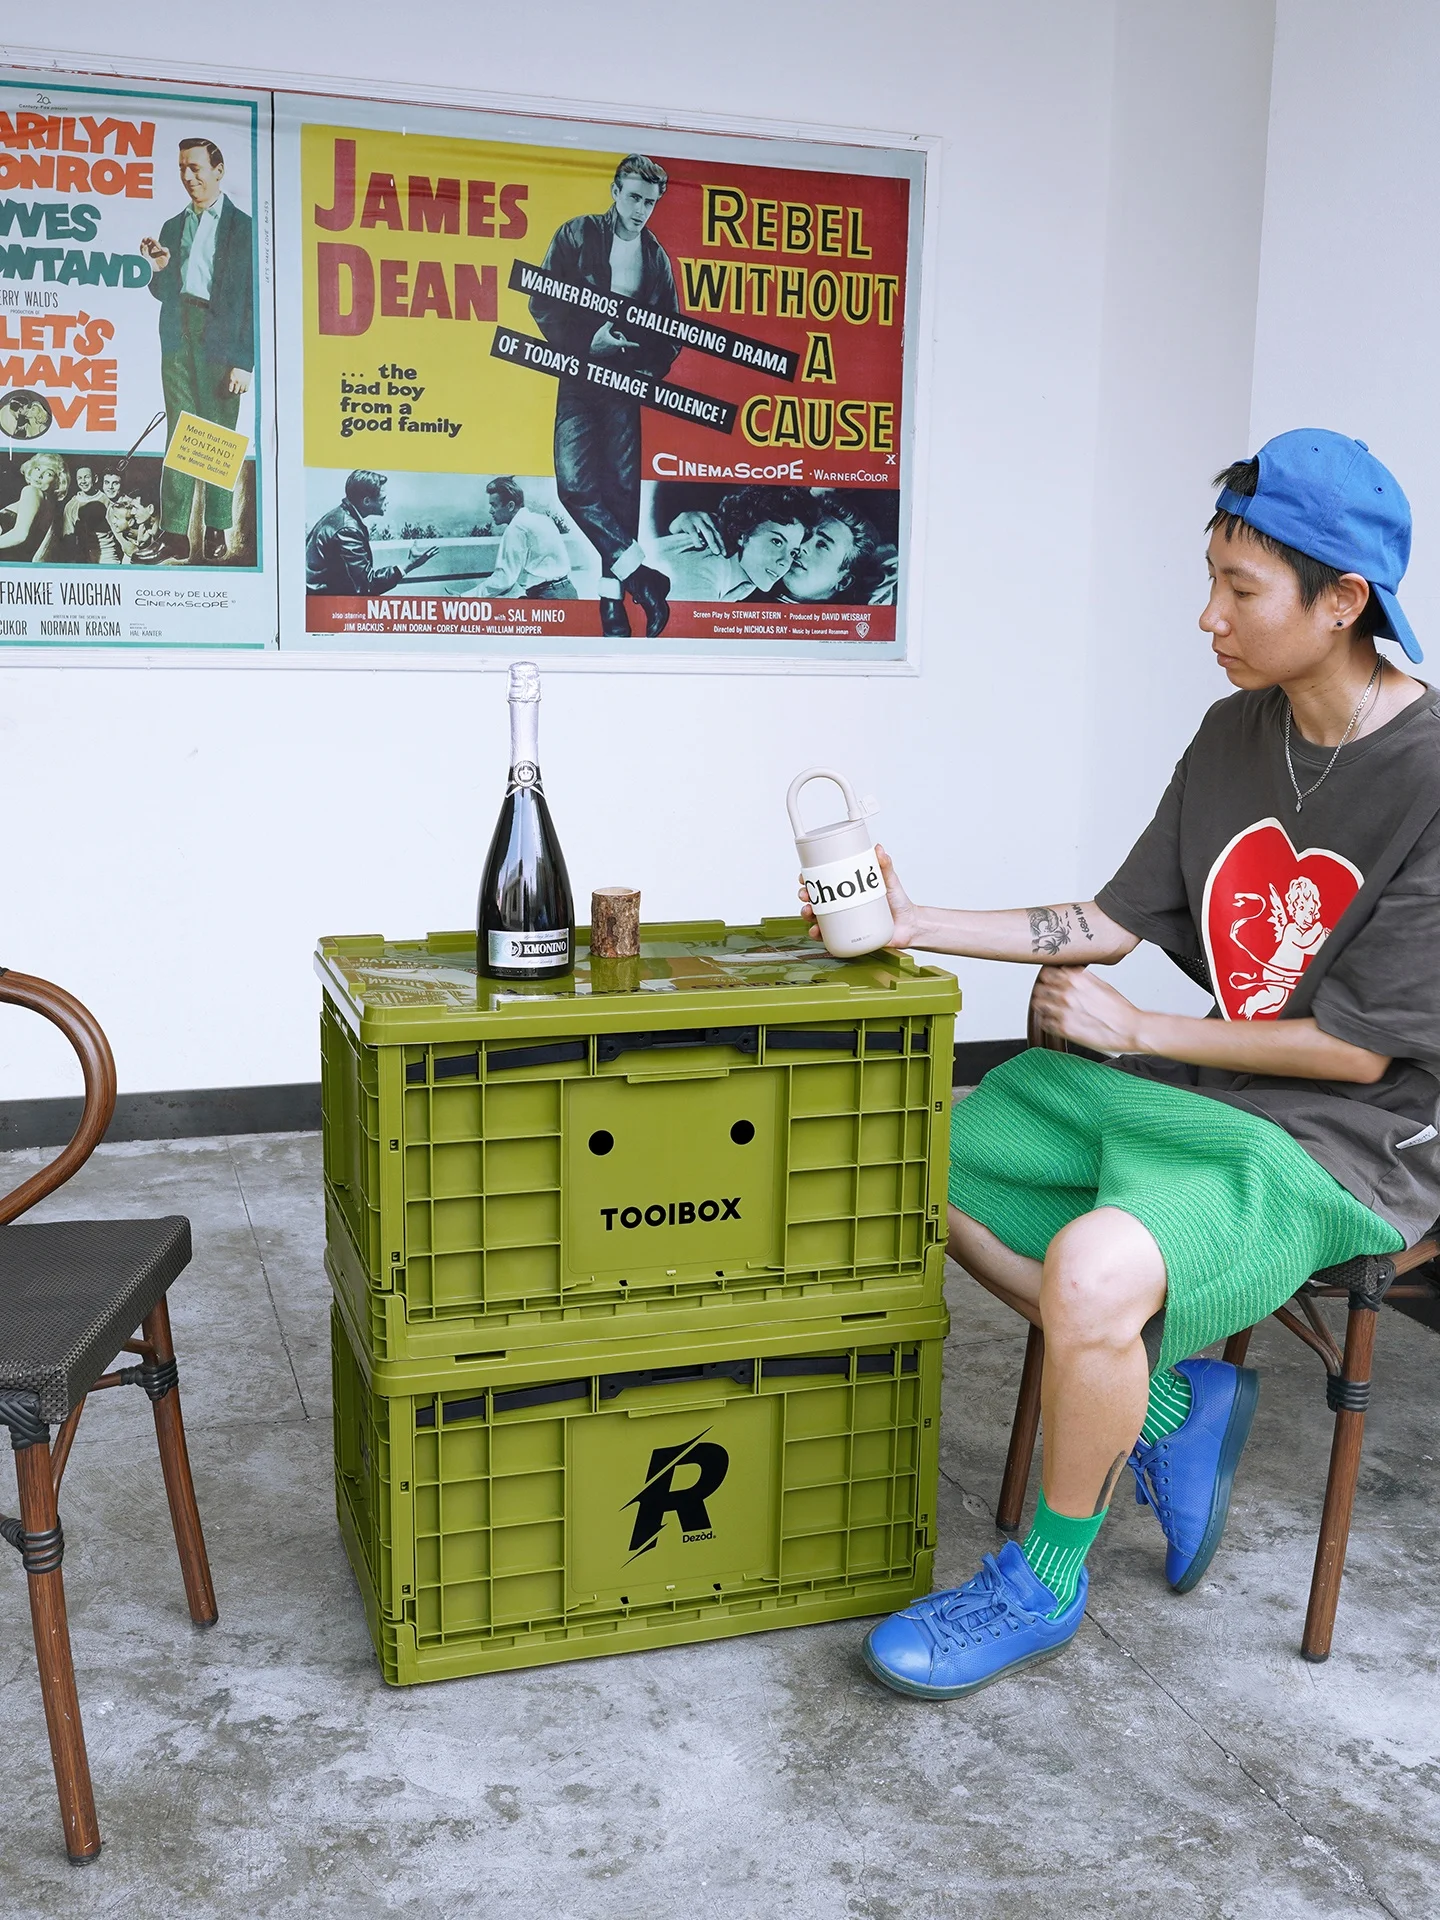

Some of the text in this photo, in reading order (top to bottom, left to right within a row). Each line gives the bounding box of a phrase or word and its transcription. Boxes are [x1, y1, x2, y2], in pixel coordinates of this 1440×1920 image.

[314, 137, 529, 240] JAMES
[701, 184, 872, 260] REBEL
[24, 291, 59, 309] WALD'S
[317, 241, 498, 337] DEAN
[677, 257, 899, 326] WITHOUT
[520, 267, 580, 305] WARNER
[626, 305, 727, 353] CHALLENGING
[731, 340, 789, 375] DRAMA
[801, 331, 837, 384] A
[378, 363, 417, 380] the
[498, 334, 727, 425] OF TODAY'S TEENAGE VIOLENCE!
[341, 379, 425, 402] bad boy
[340, 396, 412, 415] from a
[340, 416, 462, 438] good family
[741, 394, 894, 452] CAUSE
[182, 435, 235, 461] MONTAND!
[186, 424, 238, 450] Meet that man
[176, 453, 186, 461] new
[188, 457, 206, 468] Monroe
[180, 445, 190, 453] He's
[191, 449, 214, 462] dedicated
[222, 461, 231, 469] the
[0, 581, 121, 606] FRANKIE VAUGHAN
[135, 589, 171, 597] COLOR
[174, 591, 185, 599] by
[344, 612, 366, 620] starring
[367, 600, 437, 620] NATALIE
[442, 601, 492, 621] WOOD
[507, 608, 527, 622] SAL
[531, 609, 565, 623] MINEO
[693, 610, 711, 618] Screen
[711, 611, 723, 619] Play
[731, 611, 760, 619] STEWART
[761, 611, 782, 619] STERN
[821, 613, 840, 621] DAVID
[841, 613, 872, 621] WEISBART
[40, 620, 80, 636] NORMAN
[85, 621, 121, 637] KRASNA
[343, 623, 542, 634] JIM BACKUS ANN DORAN COREY ALLEN WILLIAM HOPPER
[713, 625, 735, 633] Directed
[736, 626, 743, 634] by
[743, 625, 775, 634] NICHOLAS
[775, 626, 788, 634] RAY
[805, 866, 880, 906] Cholé
[523, 941, 567, 955] KMONINO
